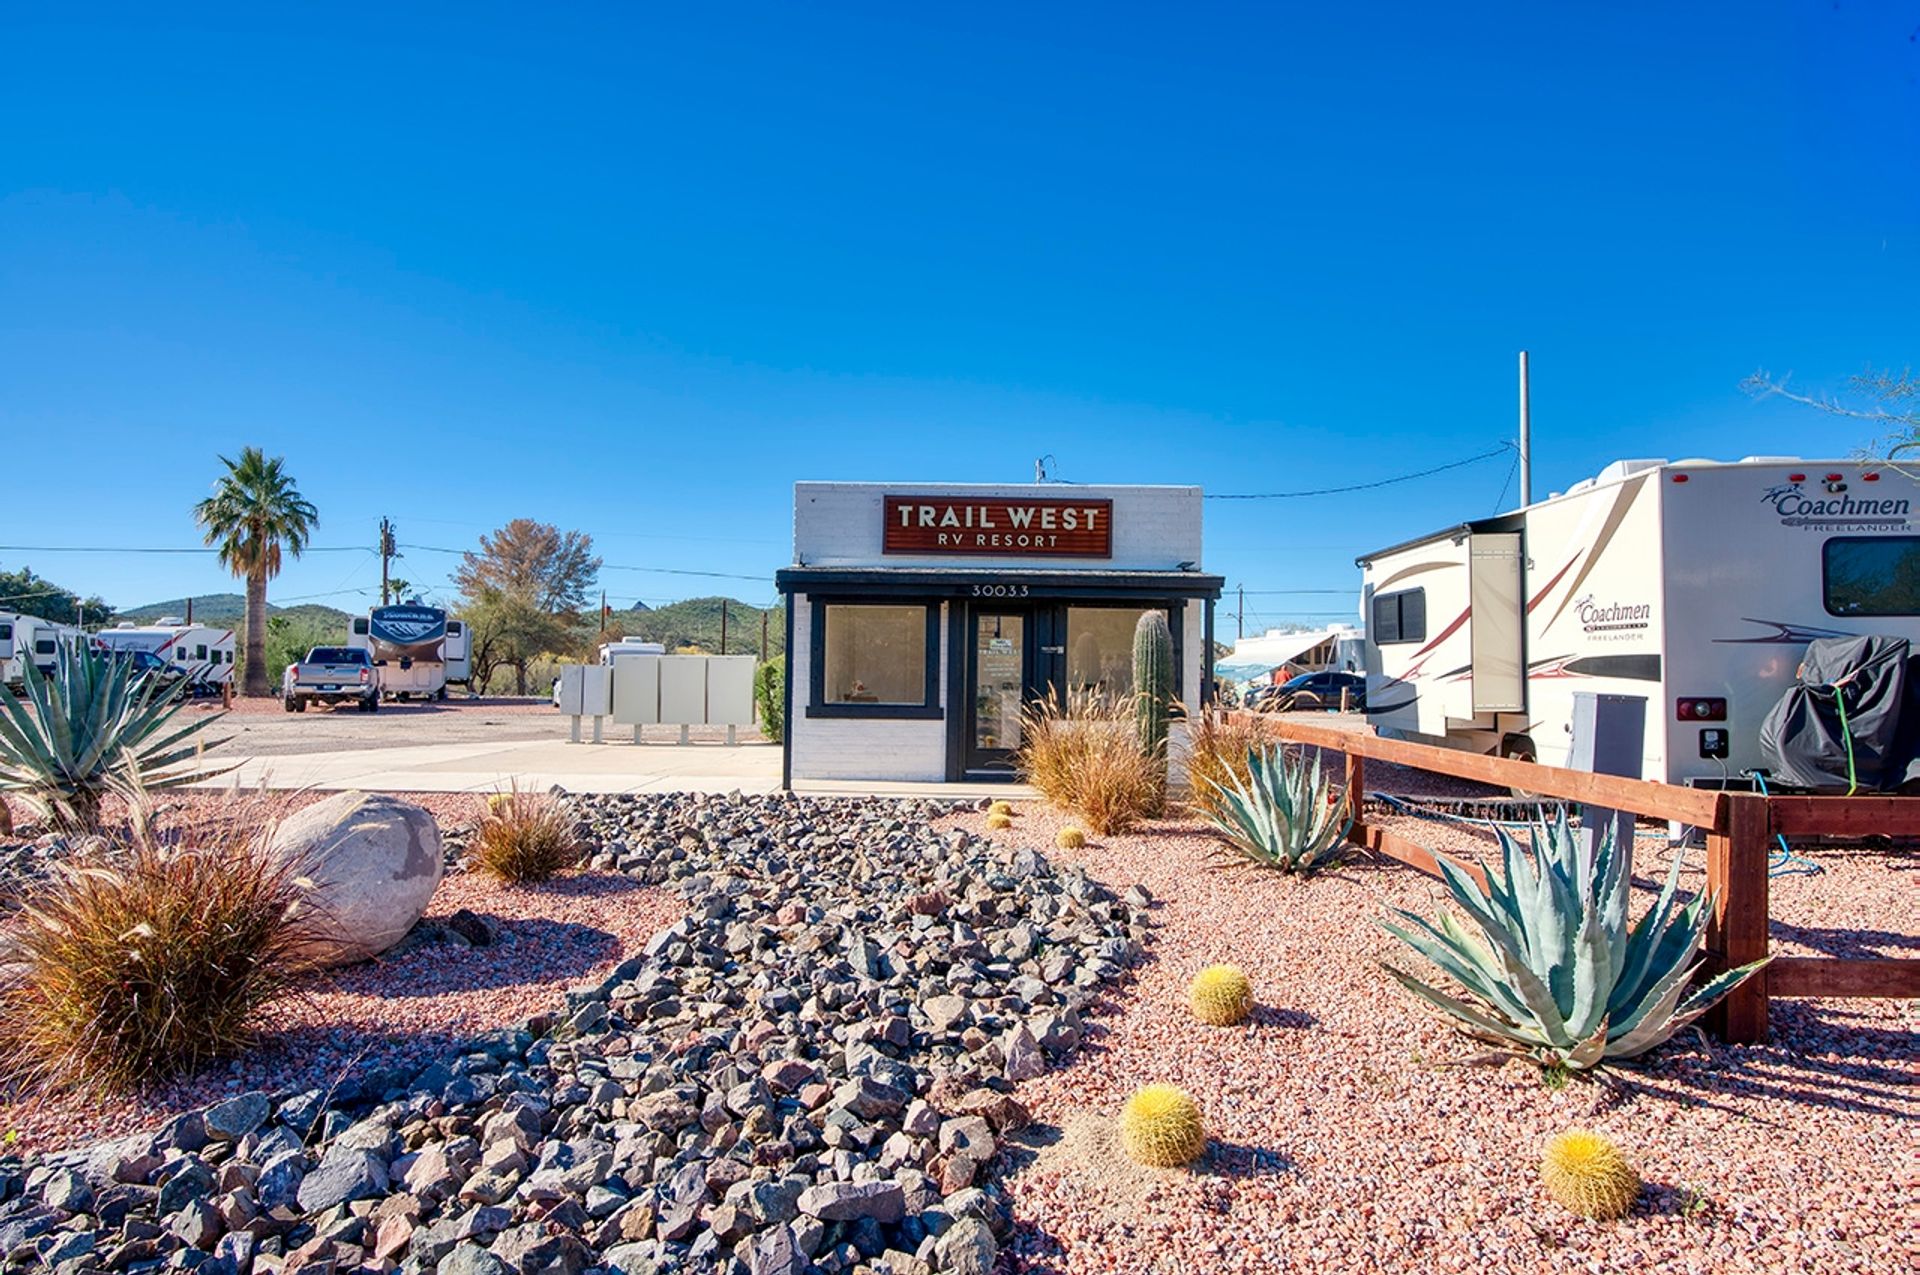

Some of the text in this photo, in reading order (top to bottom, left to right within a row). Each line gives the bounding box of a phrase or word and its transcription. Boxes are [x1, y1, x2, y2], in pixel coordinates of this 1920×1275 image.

[1776, 494, 1910, 516] Coachmen
[898, 505, 1098, 530] TRAIL WEST
[1804, 524, 1912, 532] FREELANDER
[938, 533, 1057, 547] RV RESORT
[972, 585, 1029, 597] 30033
[1581, 602, 1650, 624] Coachmen
[1587, 633, 1644, 641] FREELANDER
